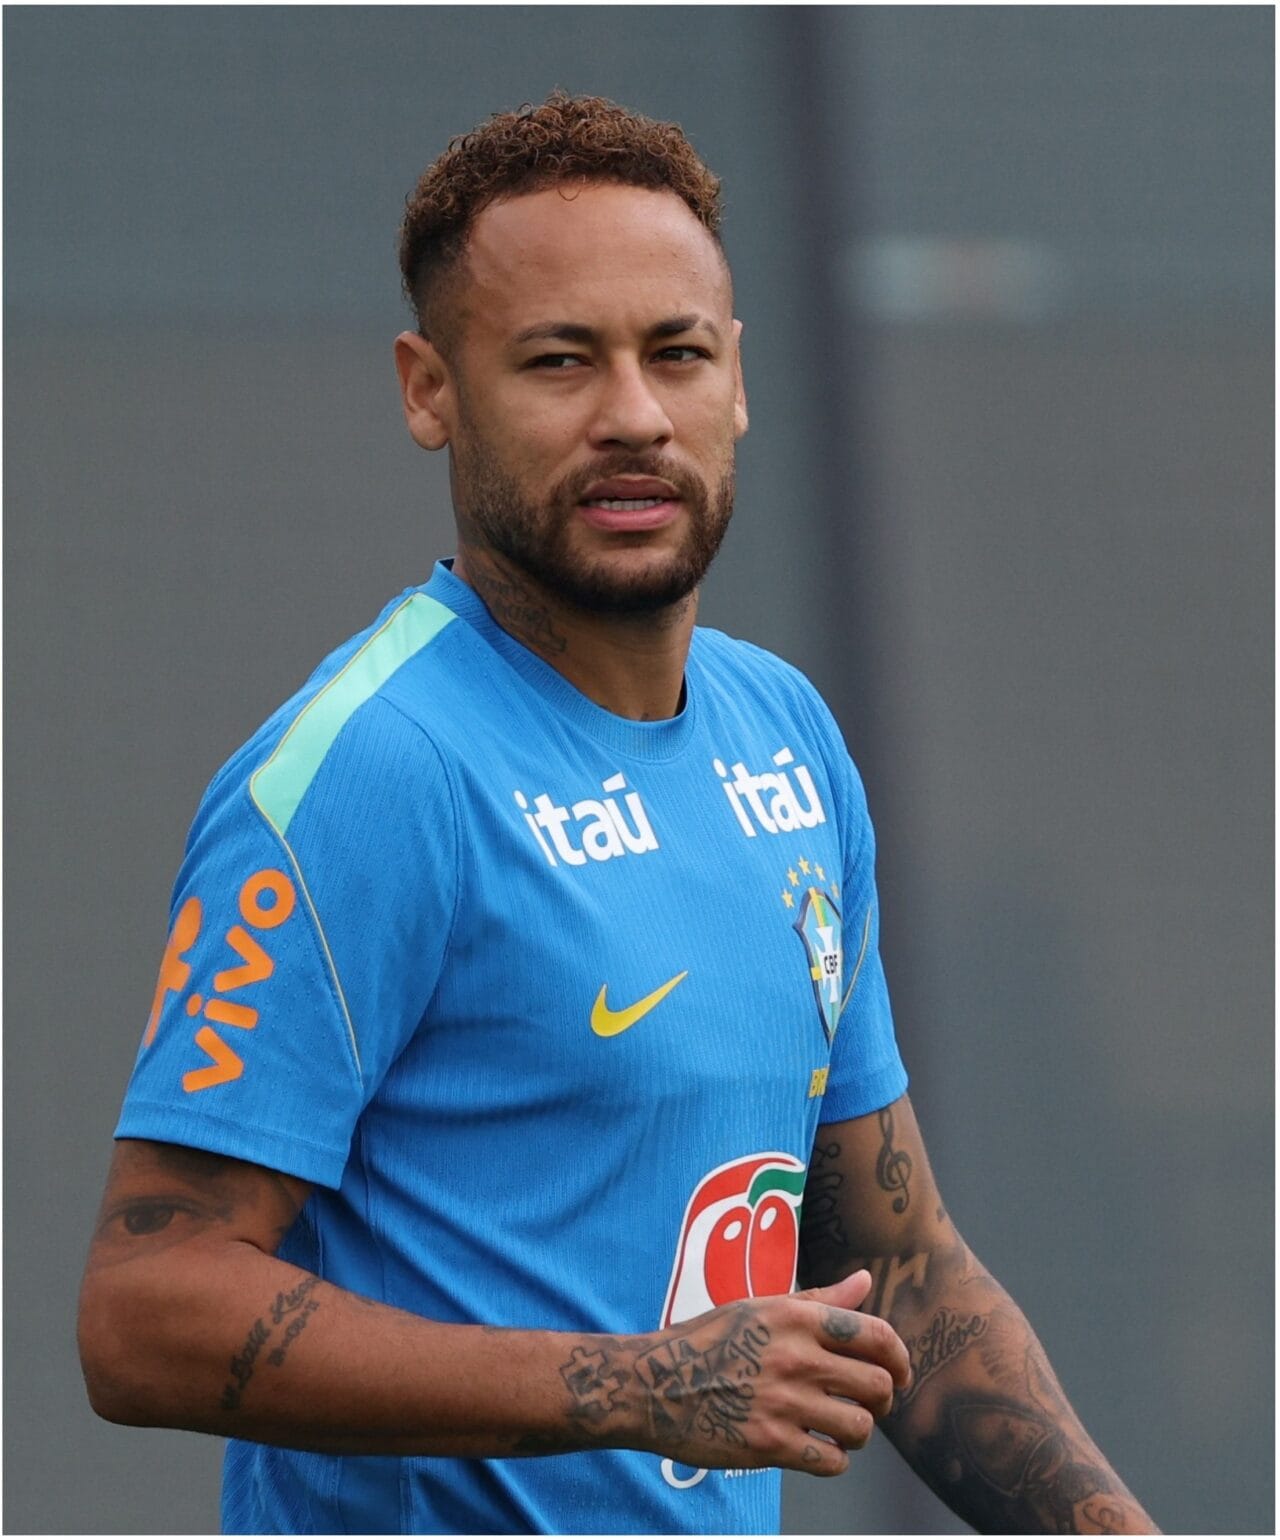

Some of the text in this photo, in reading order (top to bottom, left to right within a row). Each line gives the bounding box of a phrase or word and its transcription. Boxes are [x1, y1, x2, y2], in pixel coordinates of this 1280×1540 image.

[513, 771, 660, 868] itaú
[712, 746, 827, 838] itaú
[181, 867, 297, 1094] vivo
[823, 953, 838, 977] CBF
